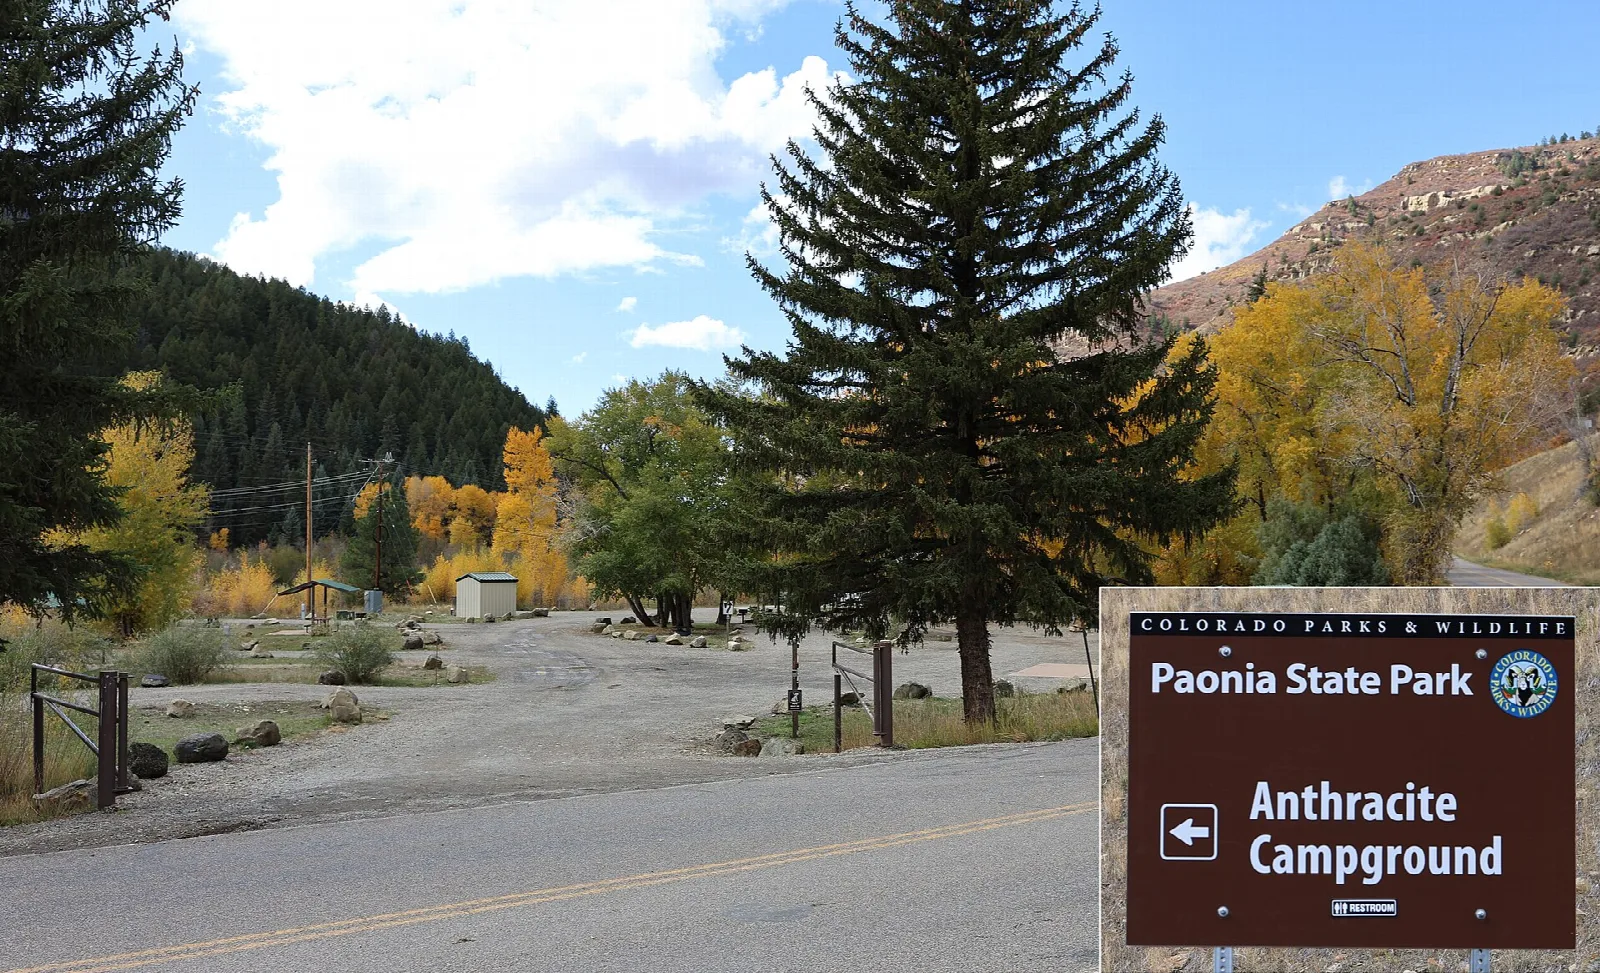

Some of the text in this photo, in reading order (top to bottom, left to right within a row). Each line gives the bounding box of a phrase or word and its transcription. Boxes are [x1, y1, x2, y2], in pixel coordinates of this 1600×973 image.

[724, 602, 732, 613] 7
[1141, 618, 1566, 635] COLORADO PARKS & WILDLIFE
[1495, 651, 1552, 672] COLORADO
[1151, 662, 1474, 696] Paonia State Park
[1491, 680, 1512, 711] PARKS
[1518, 680, 1557, 716] WILDLIFE
[1249, 781, 1457, 822] Anthracite
[1249, 833, 1503, 885] Campground
[1349, 903, 1394, 912] RESTROOM
